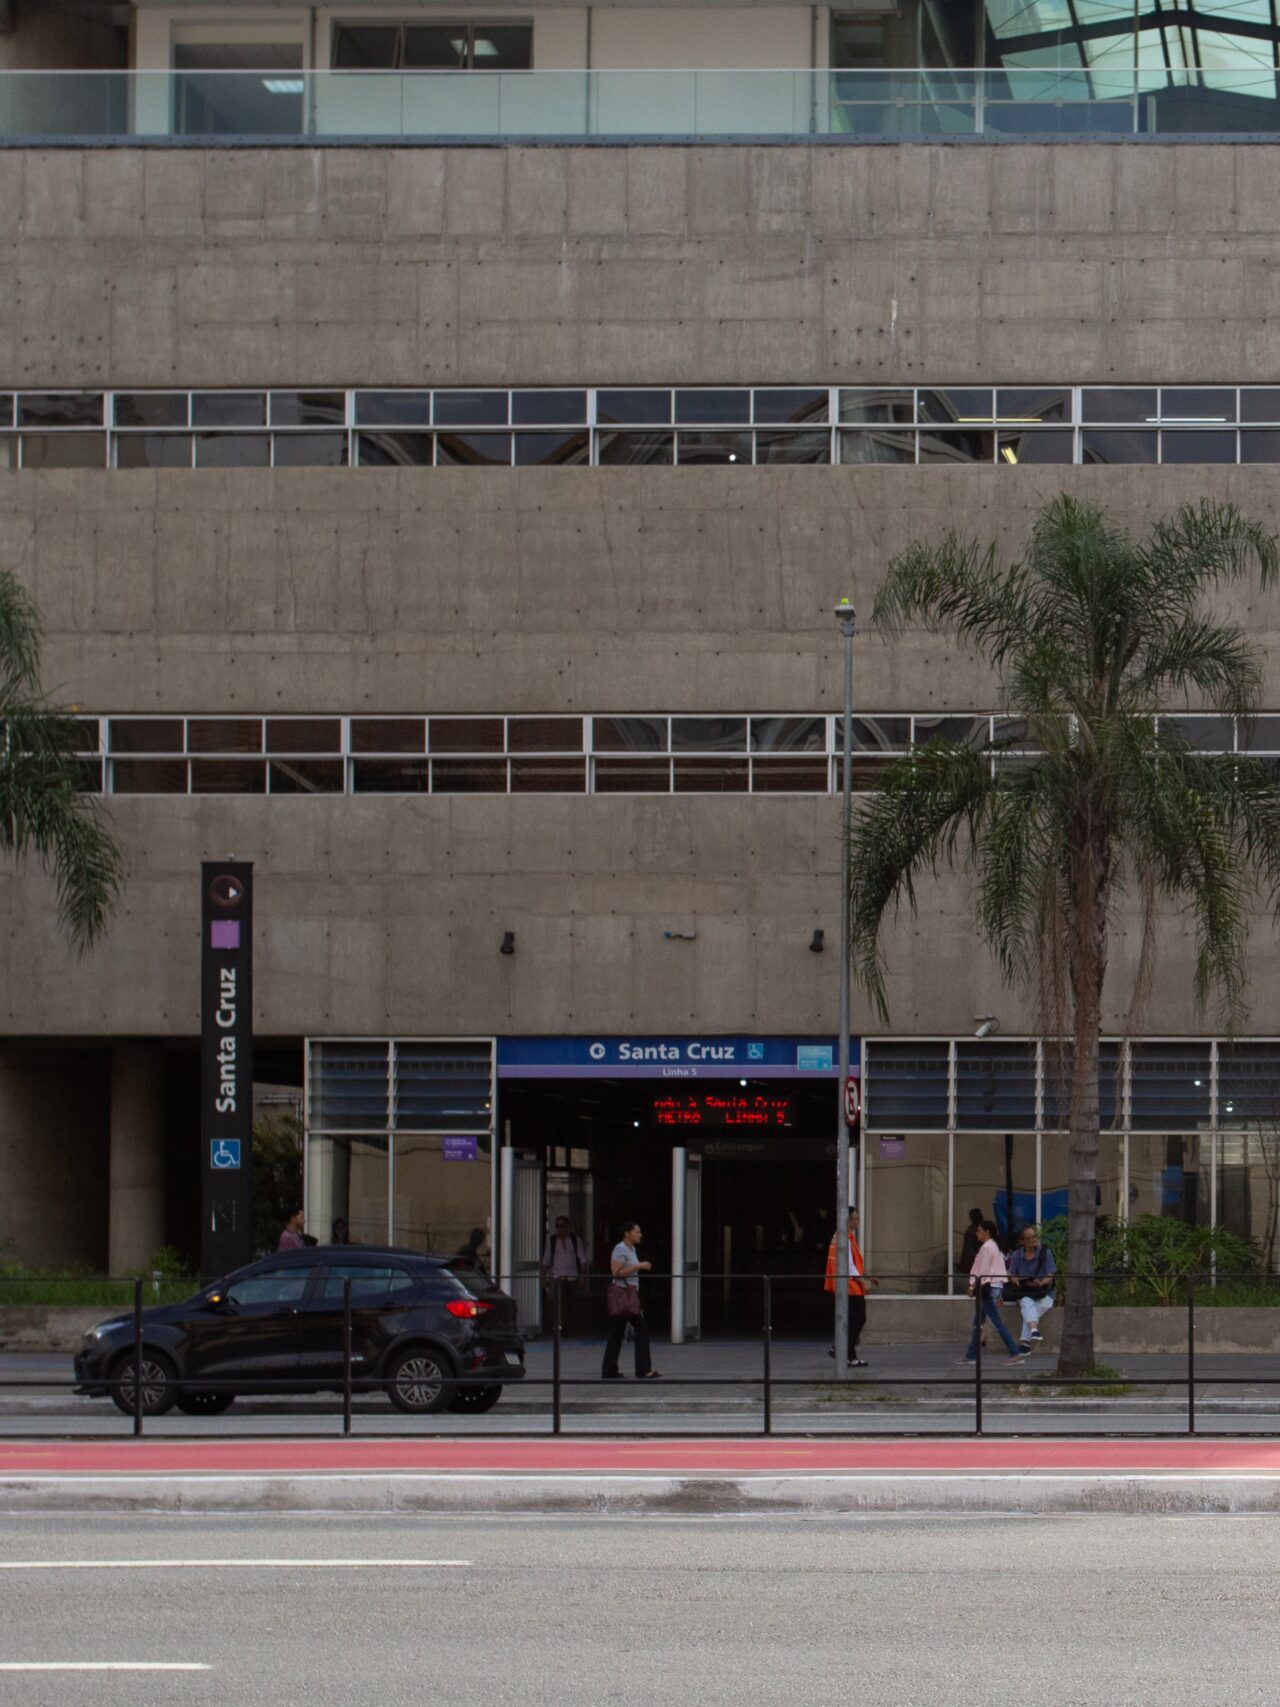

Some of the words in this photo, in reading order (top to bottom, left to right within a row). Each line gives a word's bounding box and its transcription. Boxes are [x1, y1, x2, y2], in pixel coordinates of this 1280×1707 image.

[215, 968, 236, 1028] Cruz
[619, 1043, 680, 1060] Santa
[687, 1043, 735, 1060] Cruz
[215, 1036, 236, 1112] Santa
[662, 1067, 689, 1077] Linha
[691, 1068, 697, 1077] 5
[725, 1110, 768, 1125] LINHA
